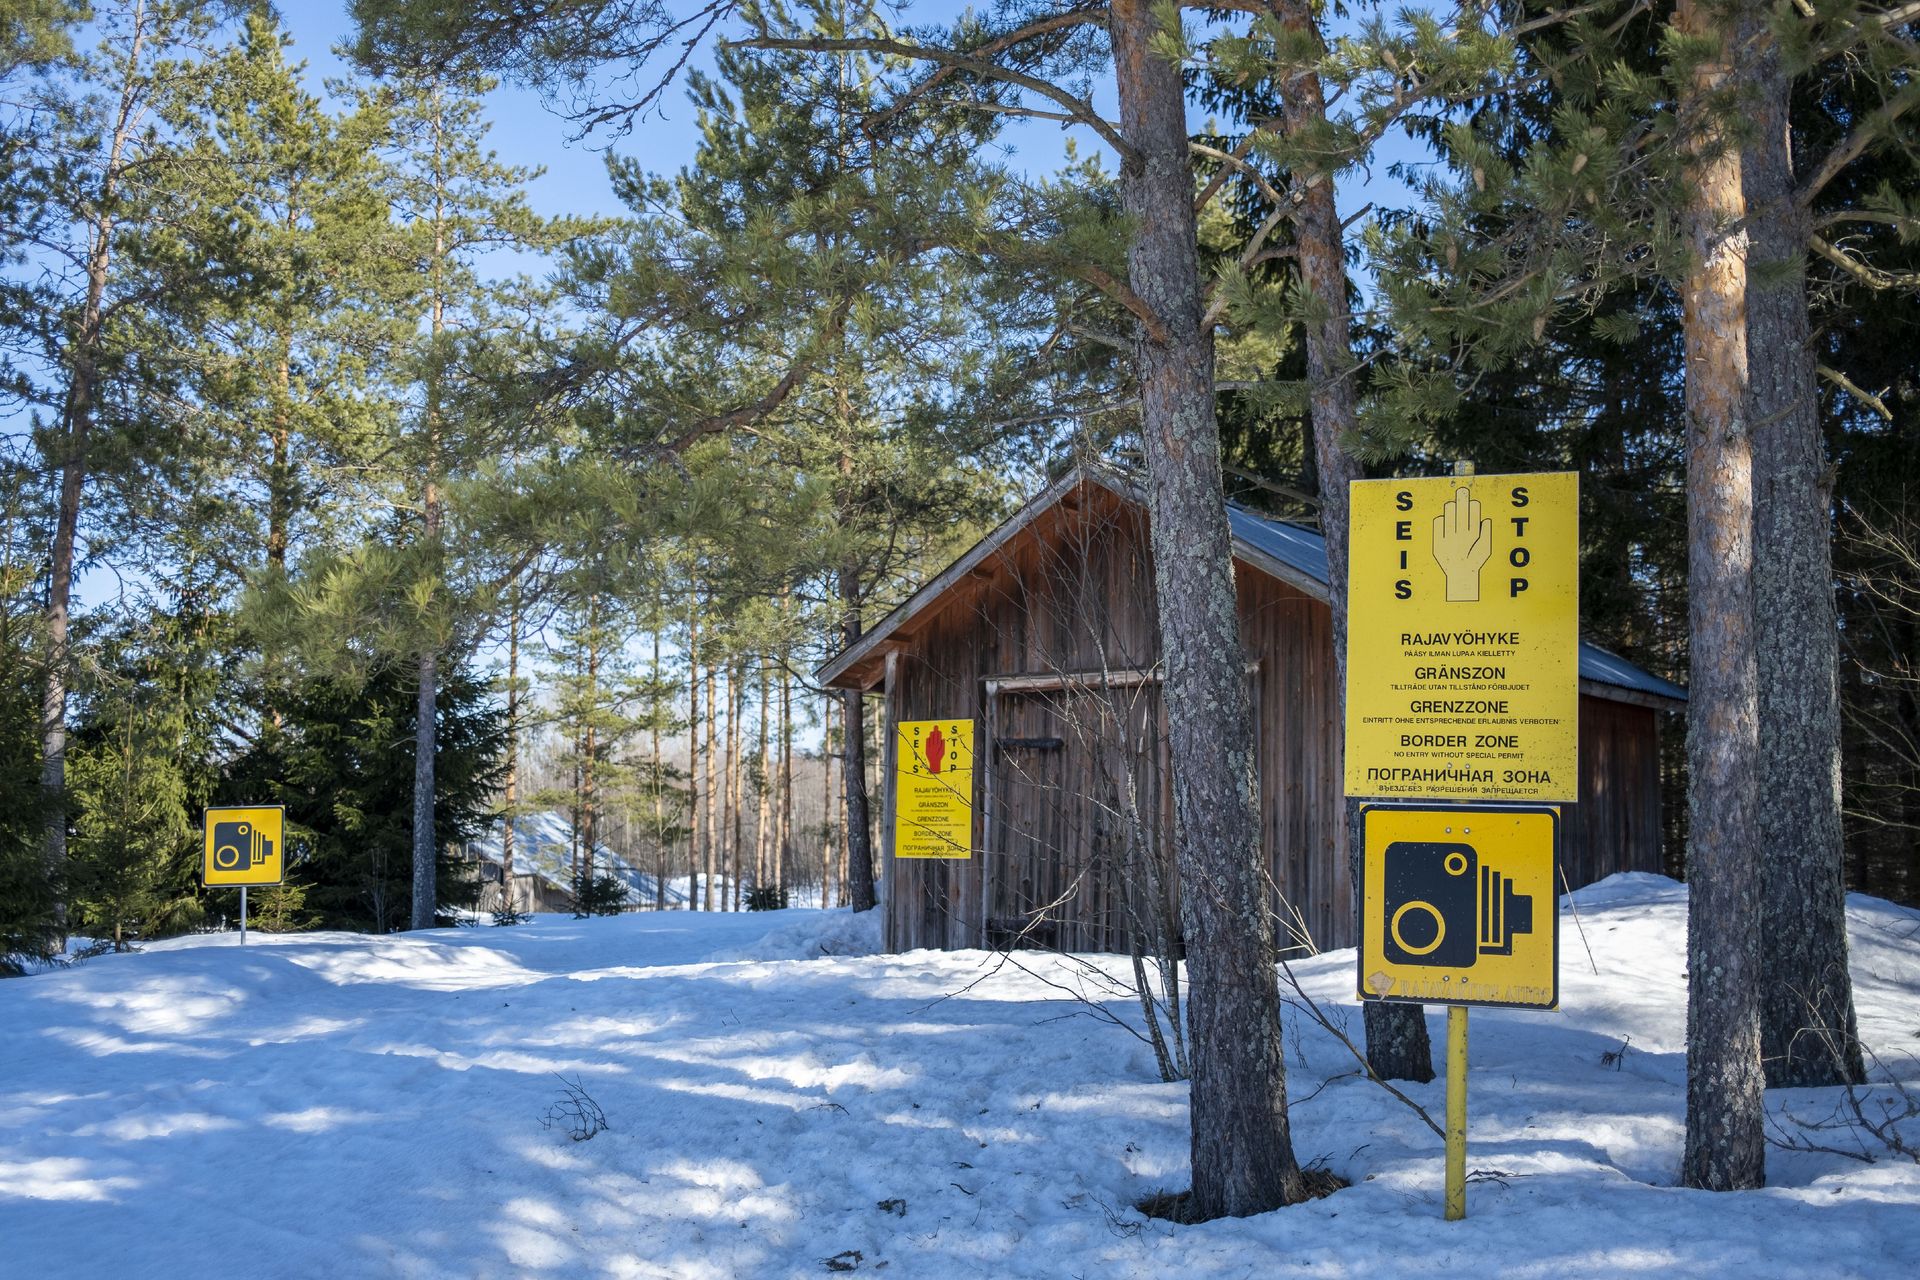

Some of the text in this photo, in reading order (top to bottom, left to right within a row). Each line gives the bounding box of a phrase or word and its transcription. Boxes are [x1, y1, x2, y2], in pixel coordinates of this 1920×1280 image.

[1395, 491, 1413, 600] SEIS
[1509, 487, 1530, 598] STOP
[1401, 629, 1520, 646] RAJAVYÖHYKE
[1414, 664, 1506, 680] GRÄNSZON
[1390, 683, 1427, 691] TILLTRÄDE
[1449, 683, 1486, 691] TILLSTÅND
[1487, 683, 1530, 691] FÖRBJUDET
[1410, 701, 1509, 714] GRENZZONE
[1415, 717, 1476, 725] ENTSPRECHENDE
[950, 725, 958, 773] STOP
[1400, 735, 1519, 748] BORDER ZONE
[1367, 767, 1551, 783] ПОГРАНИЧНАЯ ЗОНА
[917, 815, 950, 823] GRENZZONE
